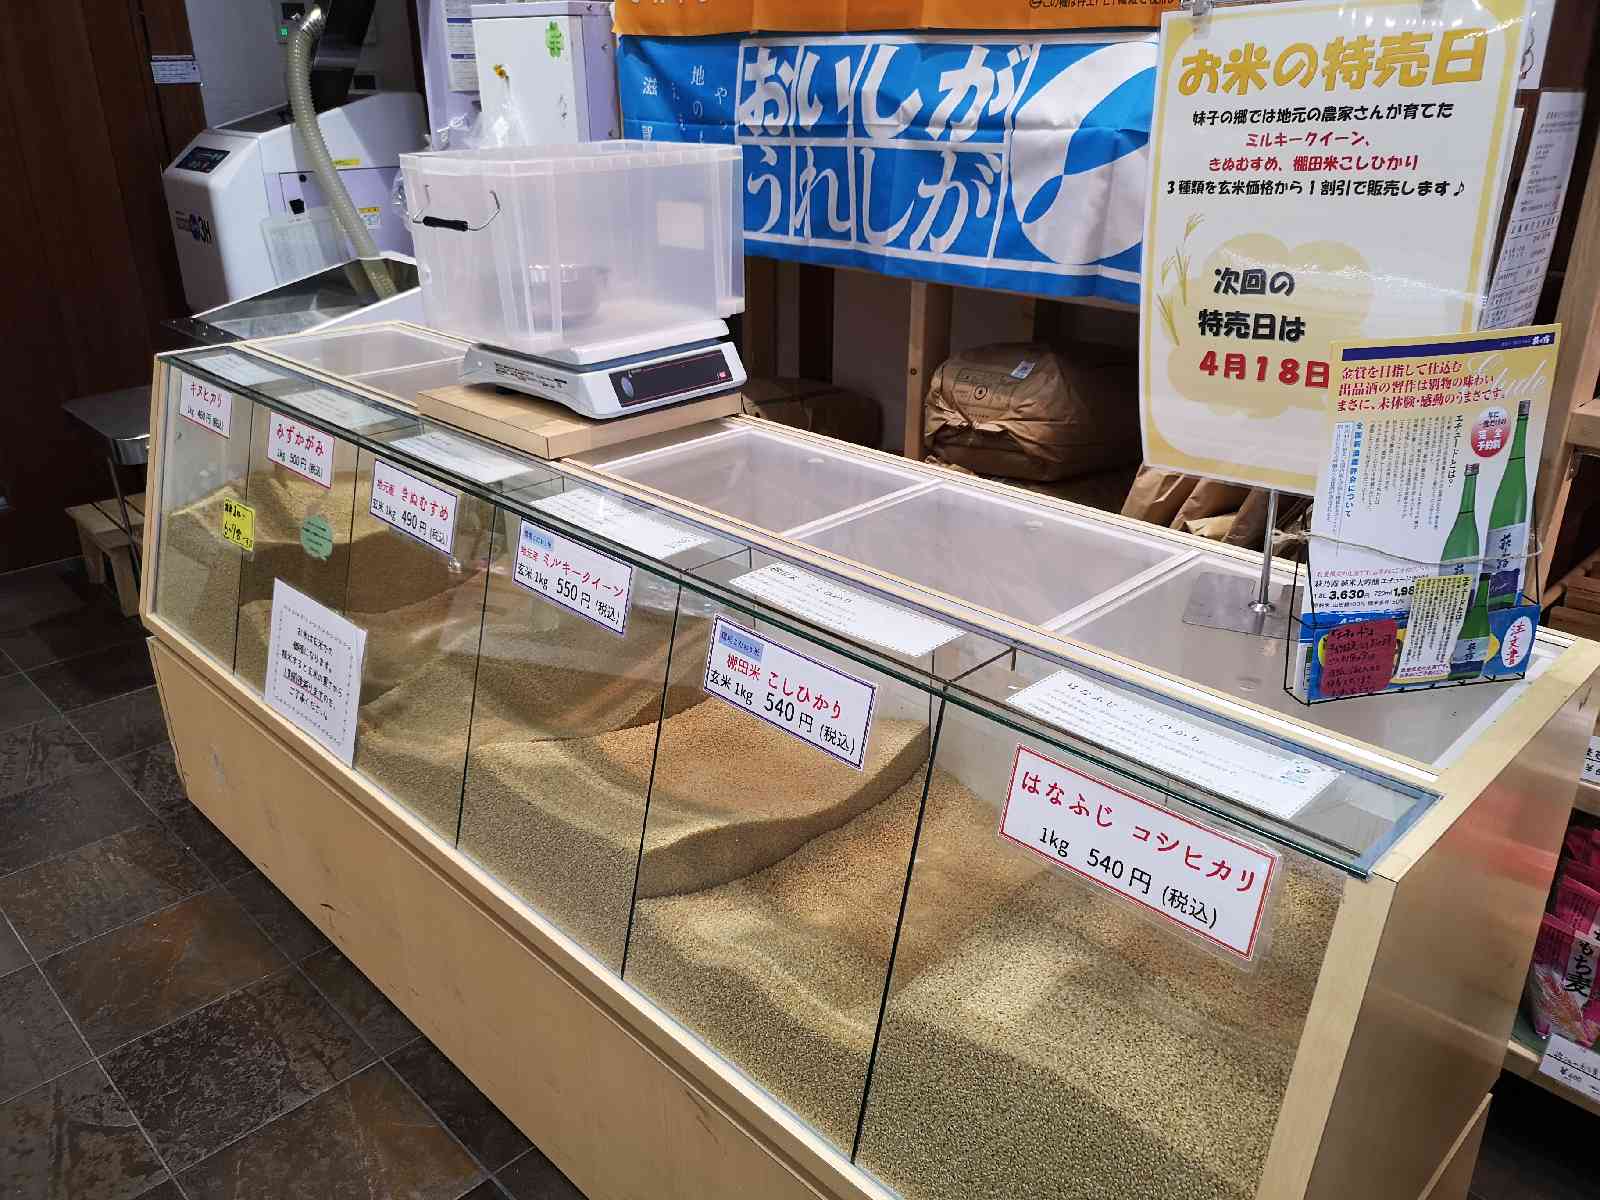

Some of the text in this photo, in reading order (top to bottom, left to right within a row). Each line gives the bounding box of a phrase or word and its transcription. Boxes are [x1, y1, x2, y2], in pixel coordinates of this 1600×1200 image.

[1178, 28, 1488, 96] お米の特売日
[740, 44, 1032, 142] おいしが
[1192, 102, 1454, 126] 妹子の郷では地元の農家さんが育てた
[1245, 131, 1371, 147] ミルキークイーン、
[747, 145, 1003, 254] うれしが
[1213, 267, 1296, 297] 次回の
[1197, 308, 1307, 343] 特売日は
[1199, 350, 1330, 389] 4月18日
[1342, 360, 1463, 380] 金賞を目指して仕込む
[190, 381, 223, 408] キヌヒカリ
[276, 423, 326, 457] みずかがみ
[371, 497, 385, 513] 玄米
[385, 503, 397, 522] 1kg
[400, 486, 449, 522] きぬむすめ
[518, 561, 532, 580] 玄米
[534, 571, 548, 591] 1kg
[543, 552, 624, 597] ミルキークイーン
[726, 652, 842, 721] 棚田米 こしひかり
[710, 668, 732, 696] 玄米
[734, 680, 754, 706] 1kg
[819, 722, 856, 756] (税込)
[1021, 770, 1255, 894] はなふじ コシヒカリ
[1039, 826, 1070, 859] 1kg
[1161, 884, 1218, 930] (税込)
[1564, 939, 1593, 999] もち麦
